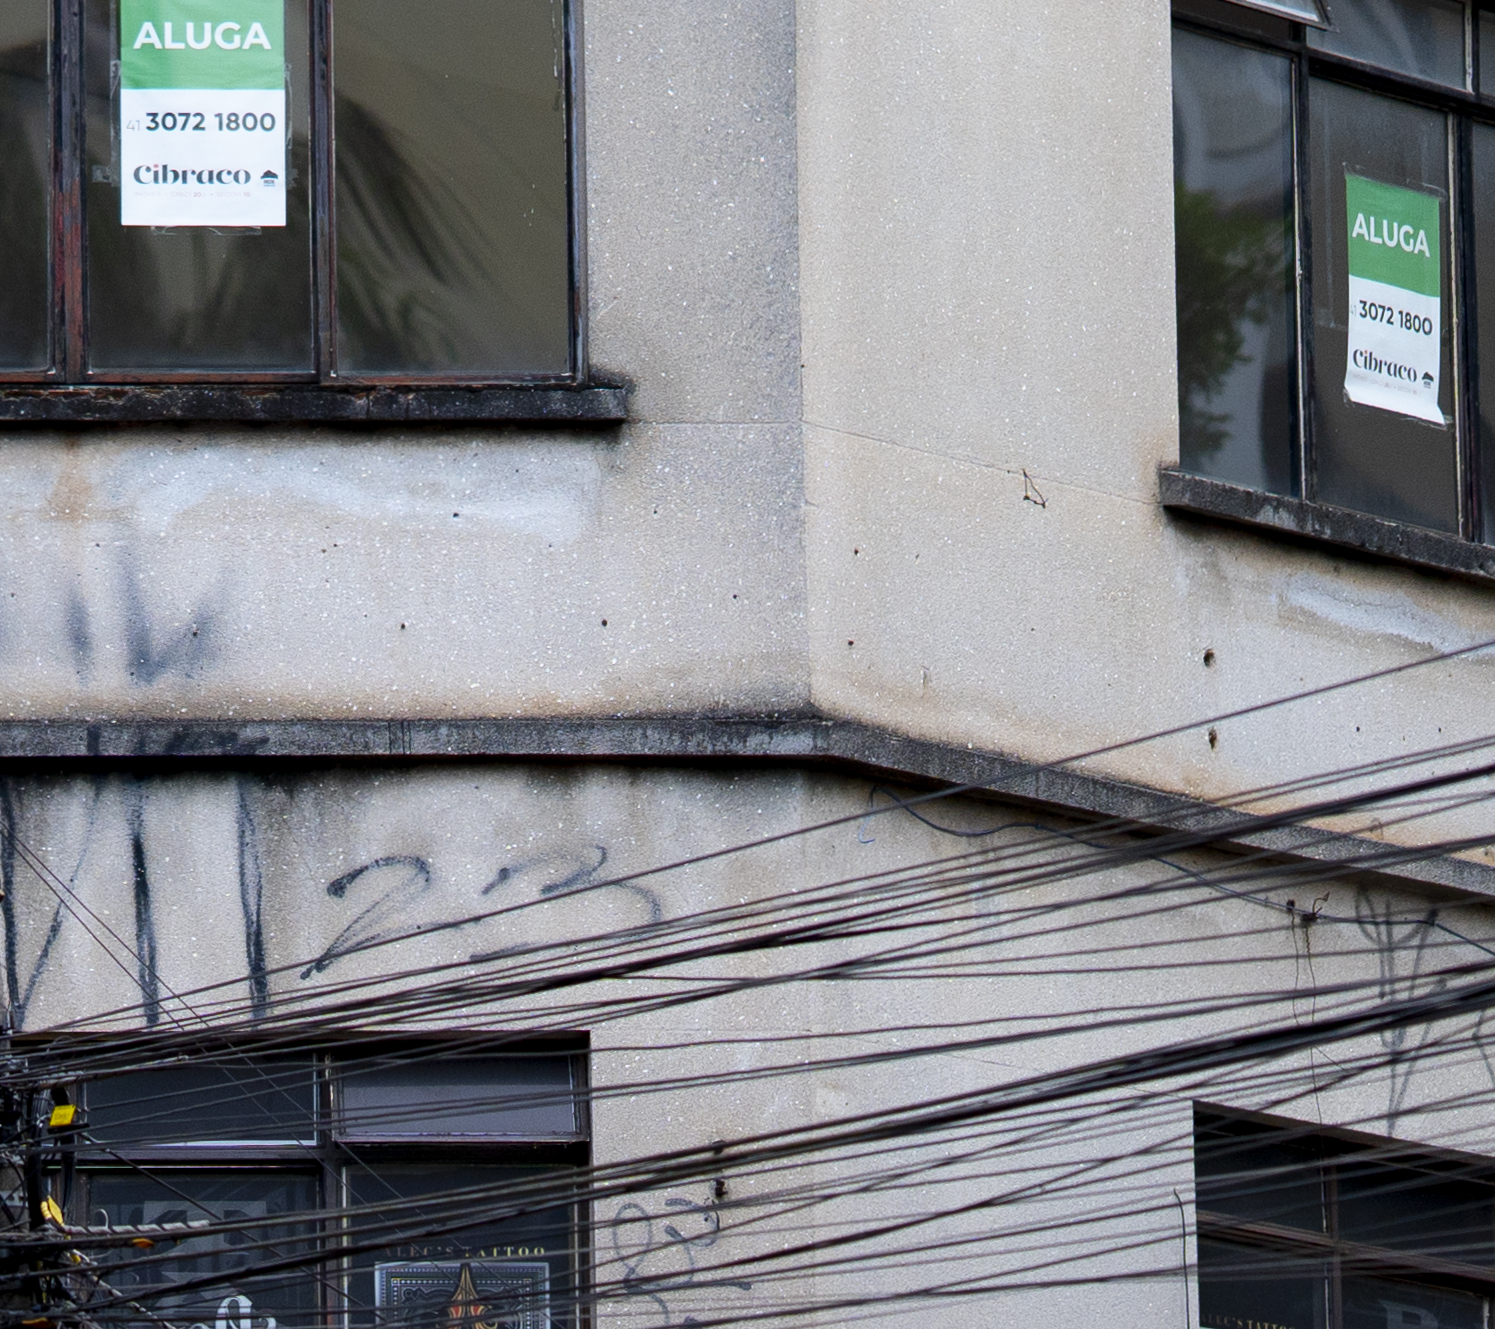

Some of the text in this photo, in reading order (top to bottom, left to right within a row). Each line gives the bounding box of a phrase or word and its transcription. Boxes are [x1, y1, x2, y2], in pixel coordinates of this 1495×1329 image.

[133, 22, 272, 50] ALUGA
[126, 112, 276, 132] 41 3072 1800
[133, 164, 251, 186] Cibraco
[1352, 212, 1431, 258] ALUGA
[1359, 299, 1394, 326] 3072
[1398, 309, 1433, 336] 1800
[1353, 347, 1417, 383] Cibraco
[462, 1246, 546, 1258] TATTOO
